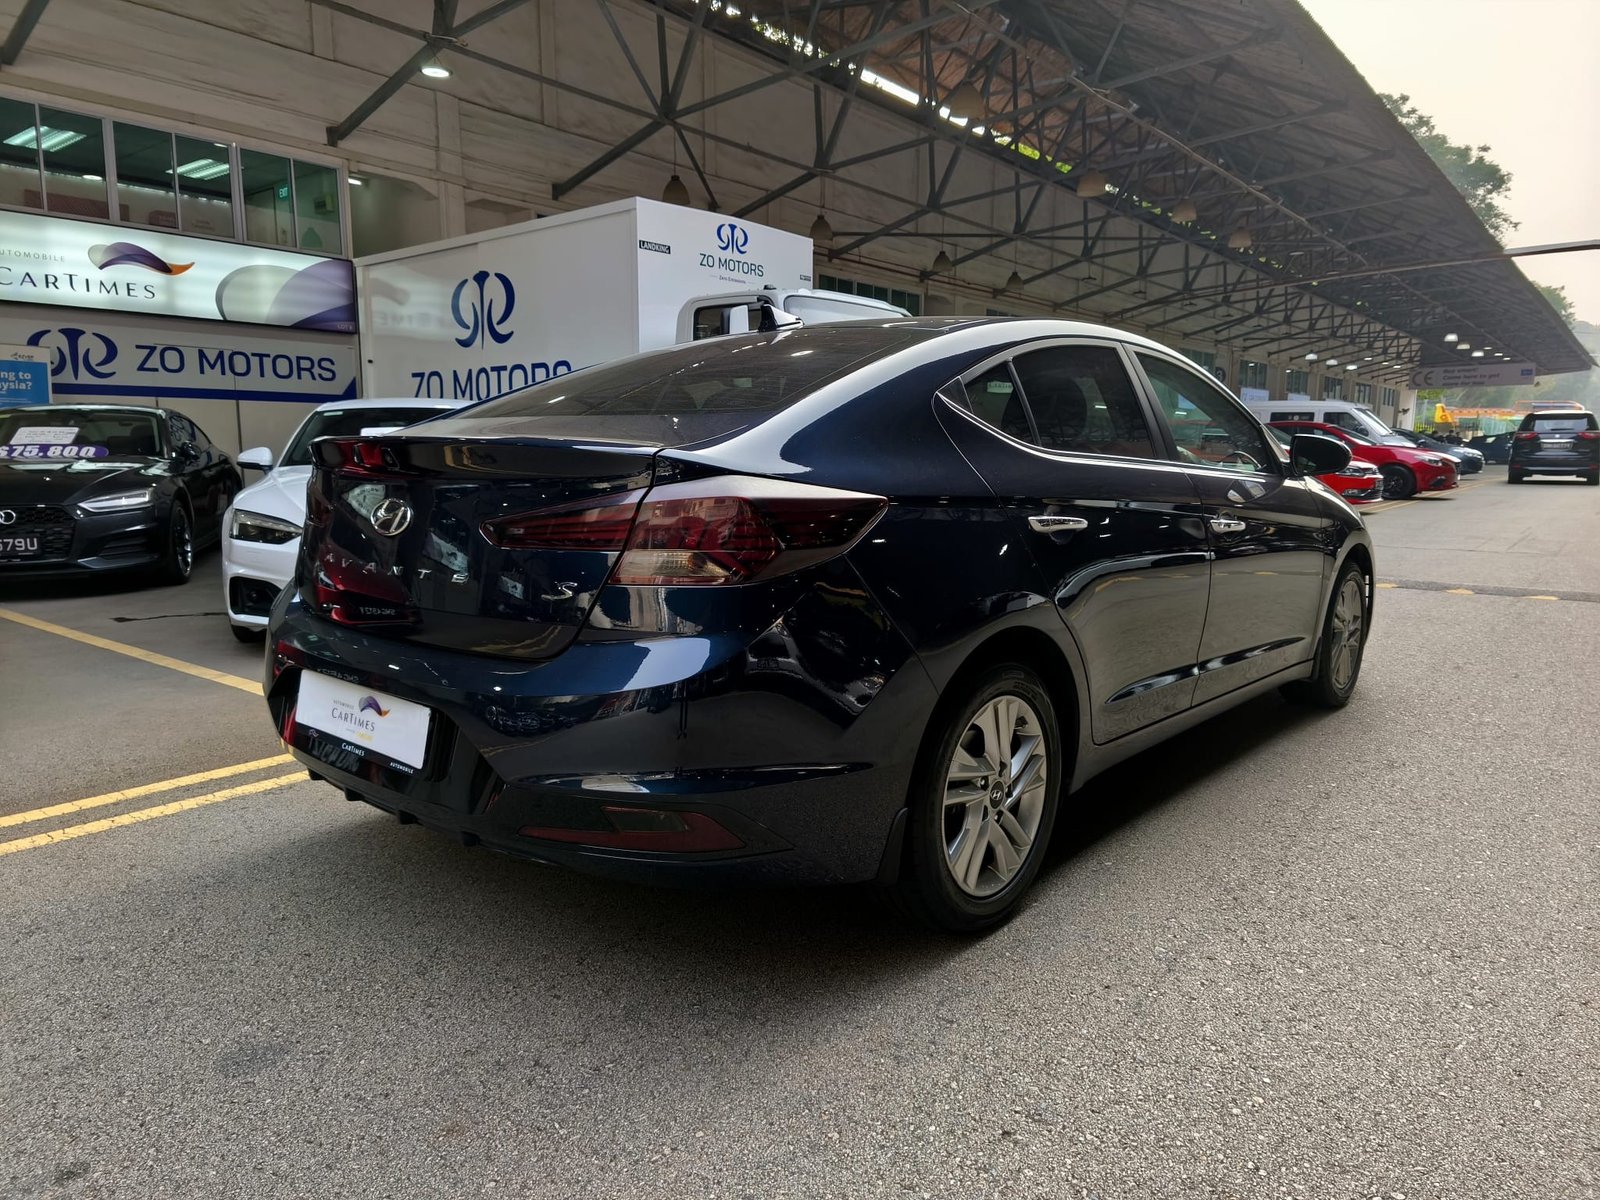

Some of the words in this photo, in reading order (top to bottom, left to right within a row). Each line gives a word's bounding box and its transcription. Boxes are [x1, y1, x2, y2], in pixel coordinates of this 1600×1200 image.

[699, 252, 715, 268] ZO
[718, 256, 764, 278] MOTORS
[135, 344, 185, 374] ZO
[197, 348, 337, 382] MOTORS
[18, 371, 31, 380] to
[0, 538, 38, 551] 79U
[324, 552, 469, 584] AVANTE
[389, 761, 414, 774] AUTOMOBILE
